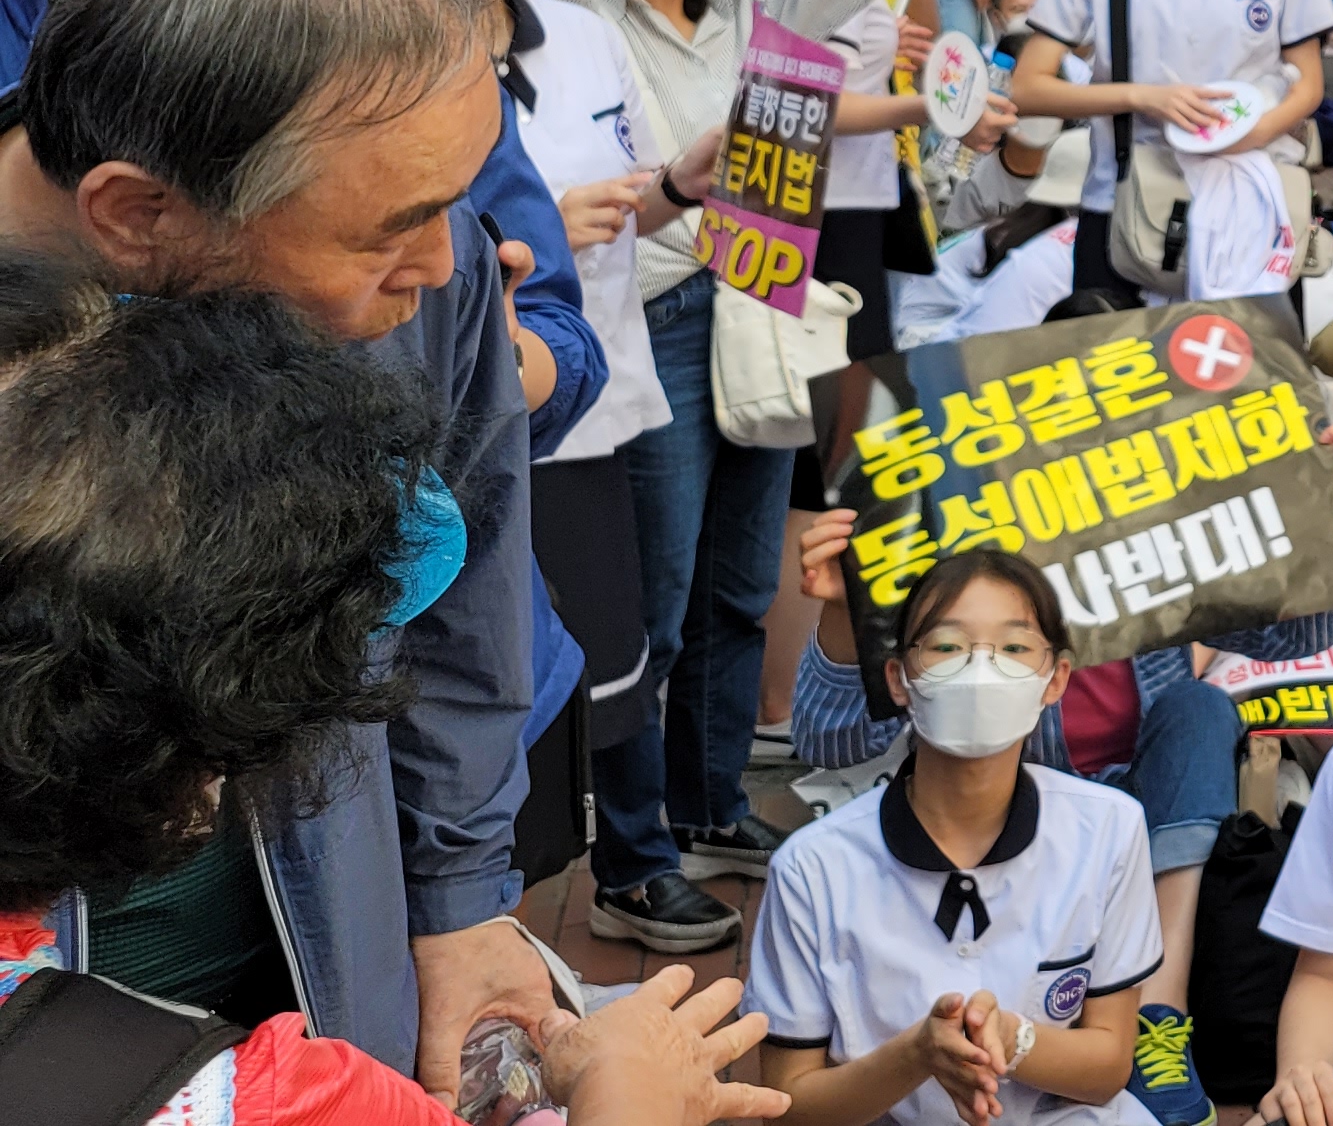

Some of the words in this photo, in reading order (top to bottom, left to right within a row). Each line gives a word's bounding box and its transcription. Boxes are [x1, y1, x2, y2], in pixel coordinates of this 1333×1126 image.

[848, 381, 1317, 608] 동성애법제화
[851, 335, 1175, 502] 동성결혼
[1055, 984, 1086, 1008] DICS
